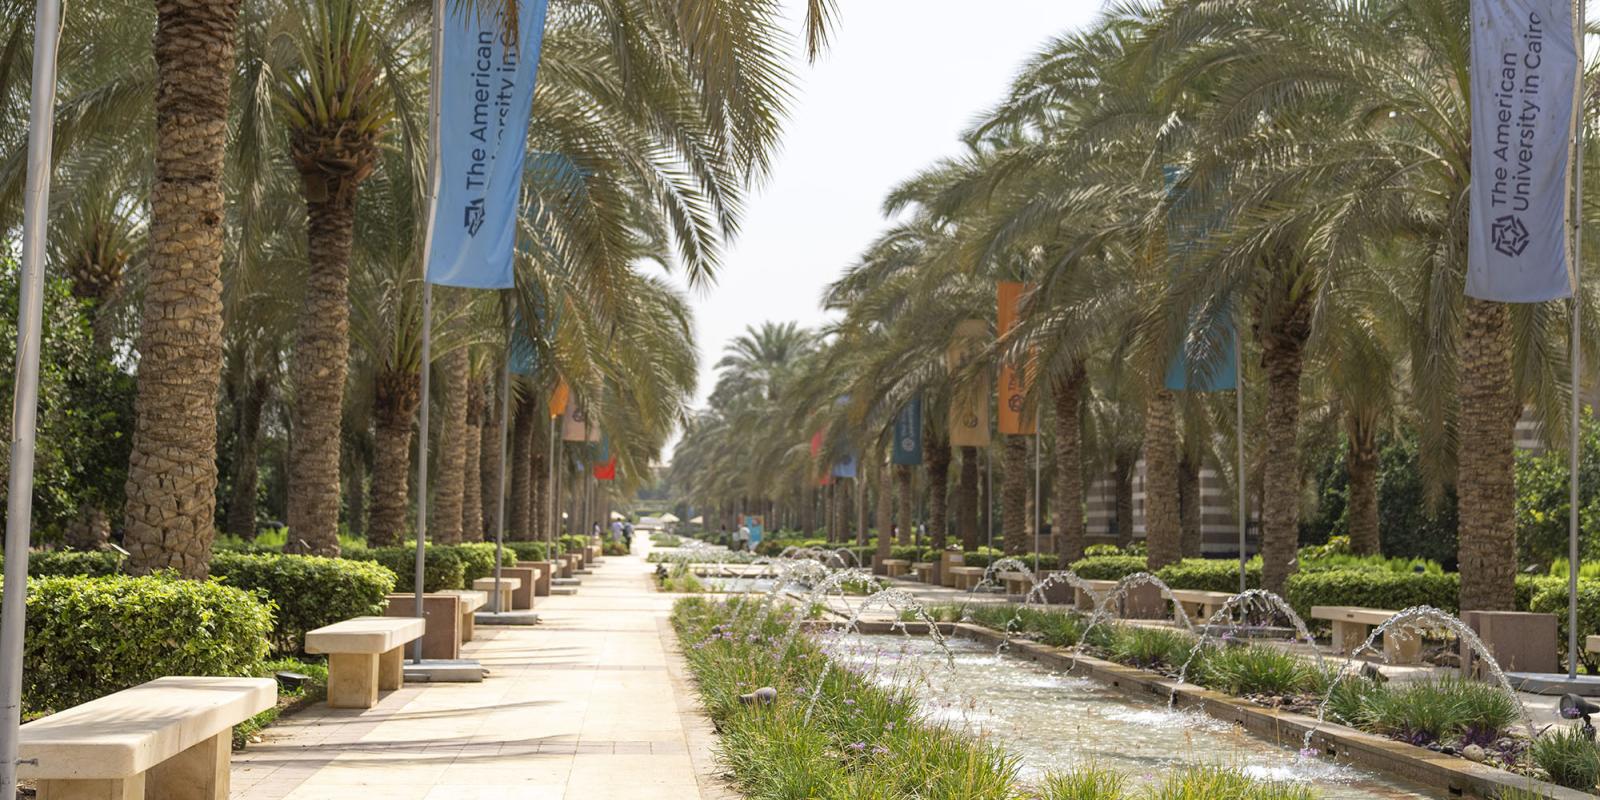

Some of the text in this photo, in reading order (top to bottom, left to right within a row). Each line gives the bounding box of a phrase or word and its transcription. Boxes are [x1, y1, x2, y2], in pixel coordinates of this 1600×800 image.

[466, 31, 493, 191] The American
[496, 53, 517, 72] in
[1491, 52, 1518, 208] The American
[1512, 11, 1543, 212] University in Cairo
